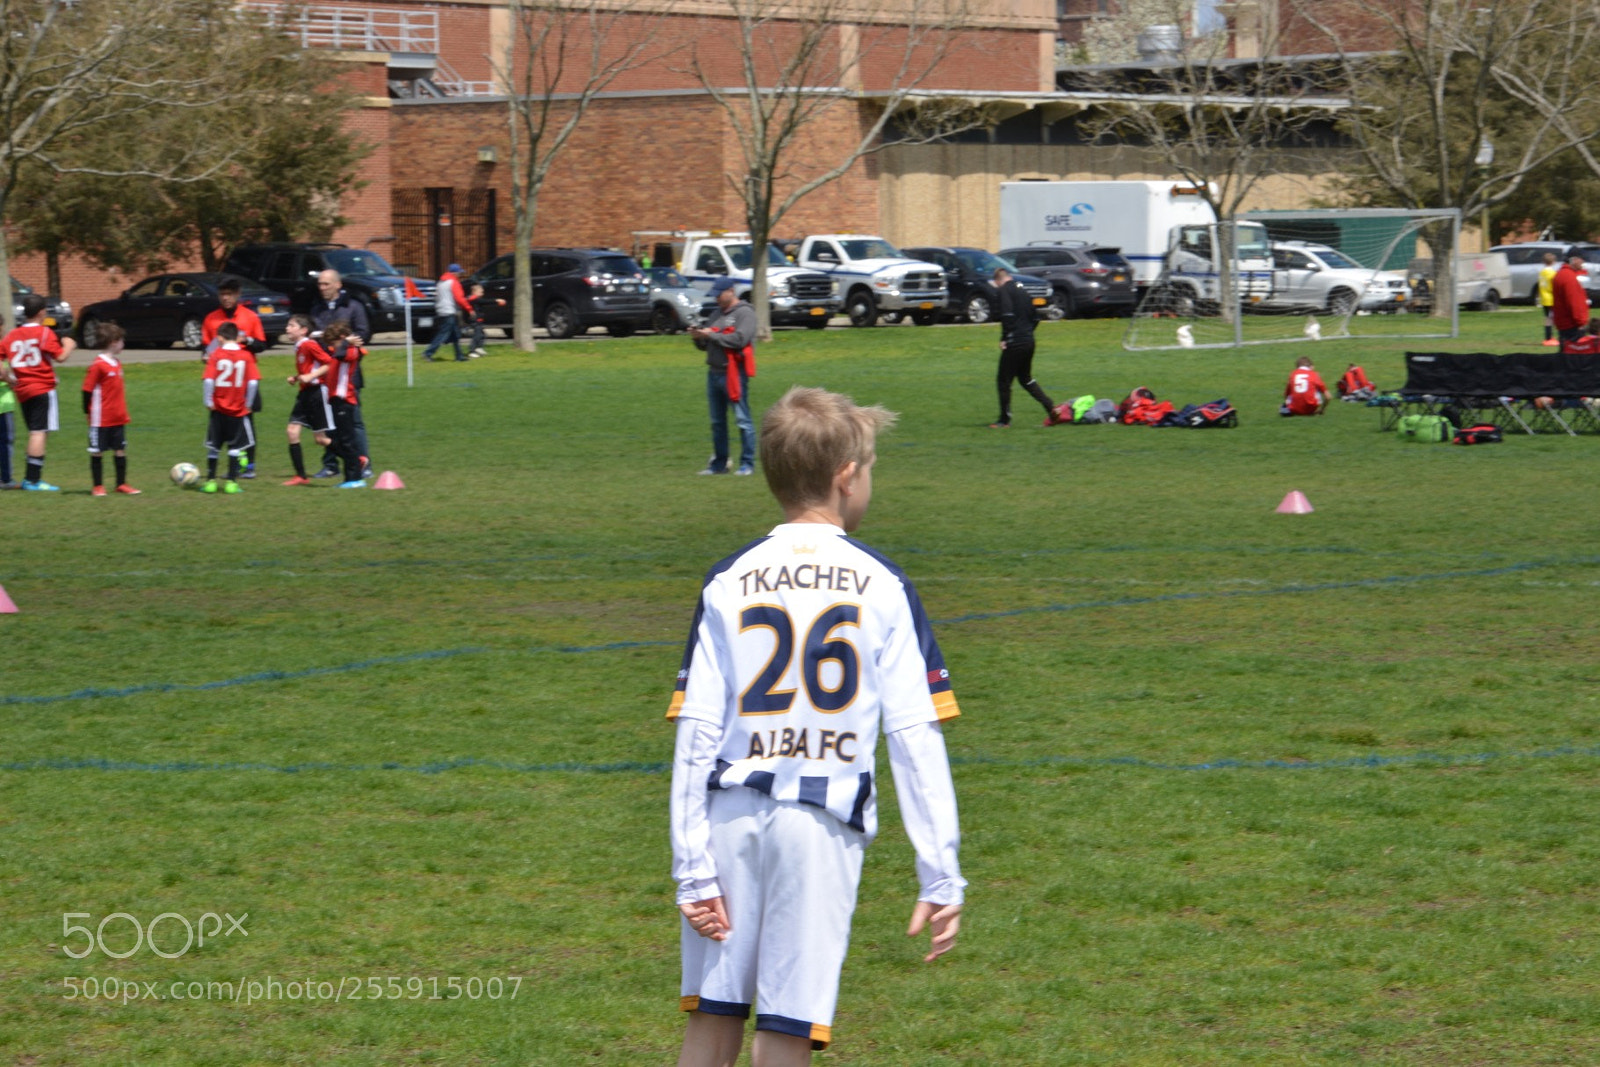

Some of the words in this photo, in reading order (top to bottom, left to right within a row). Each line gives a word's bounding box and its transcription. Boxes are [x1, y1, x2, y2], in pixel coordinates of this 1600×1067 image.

[1045, 214, 1071, 226] SAFE
[10, 339, 42, 368] 25
[215, 359, 246, 388] 21
[1294, 373, 1309, 393] 5
[739, 564, 871, 597] TKACHEV
[738, 601, 863, 717] 26
[747, 727, 809, 760] ALBA
[818, 729, 858, 763] FC
